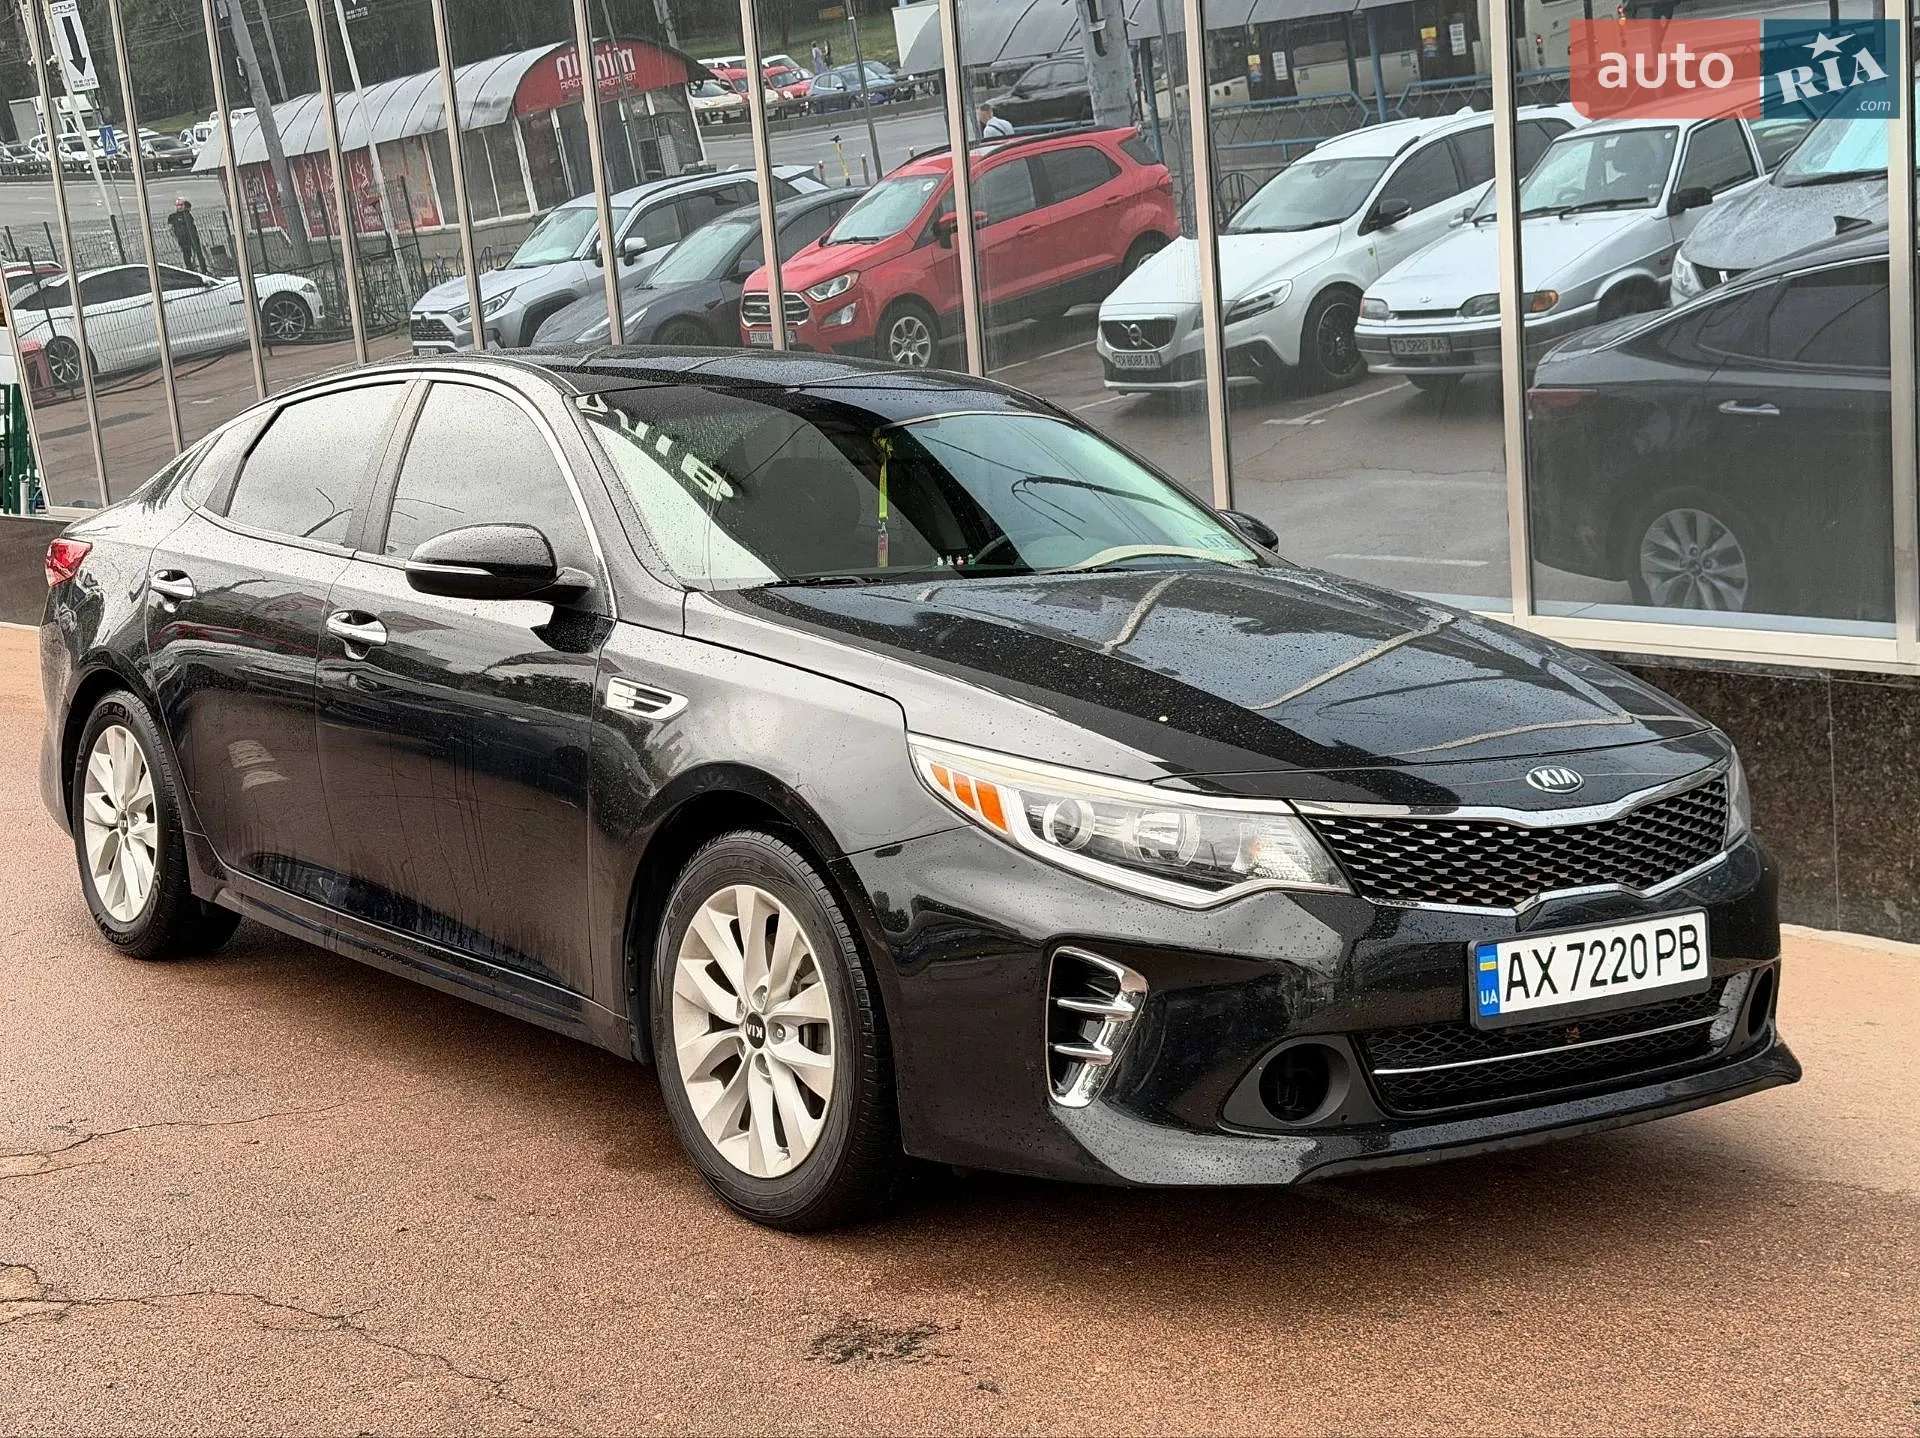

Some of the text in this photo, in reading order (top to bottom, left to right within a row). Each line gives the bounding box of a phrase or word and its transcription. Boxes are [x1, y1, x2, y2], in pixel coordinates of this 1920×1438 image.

[1533, 768, 1579, 788] KIA
[1505, 923, 1702, 1002] AX 7220 PB
[1480, 989, 1499, 1006] UA
[745, 1022, 764, 1039] KIA
